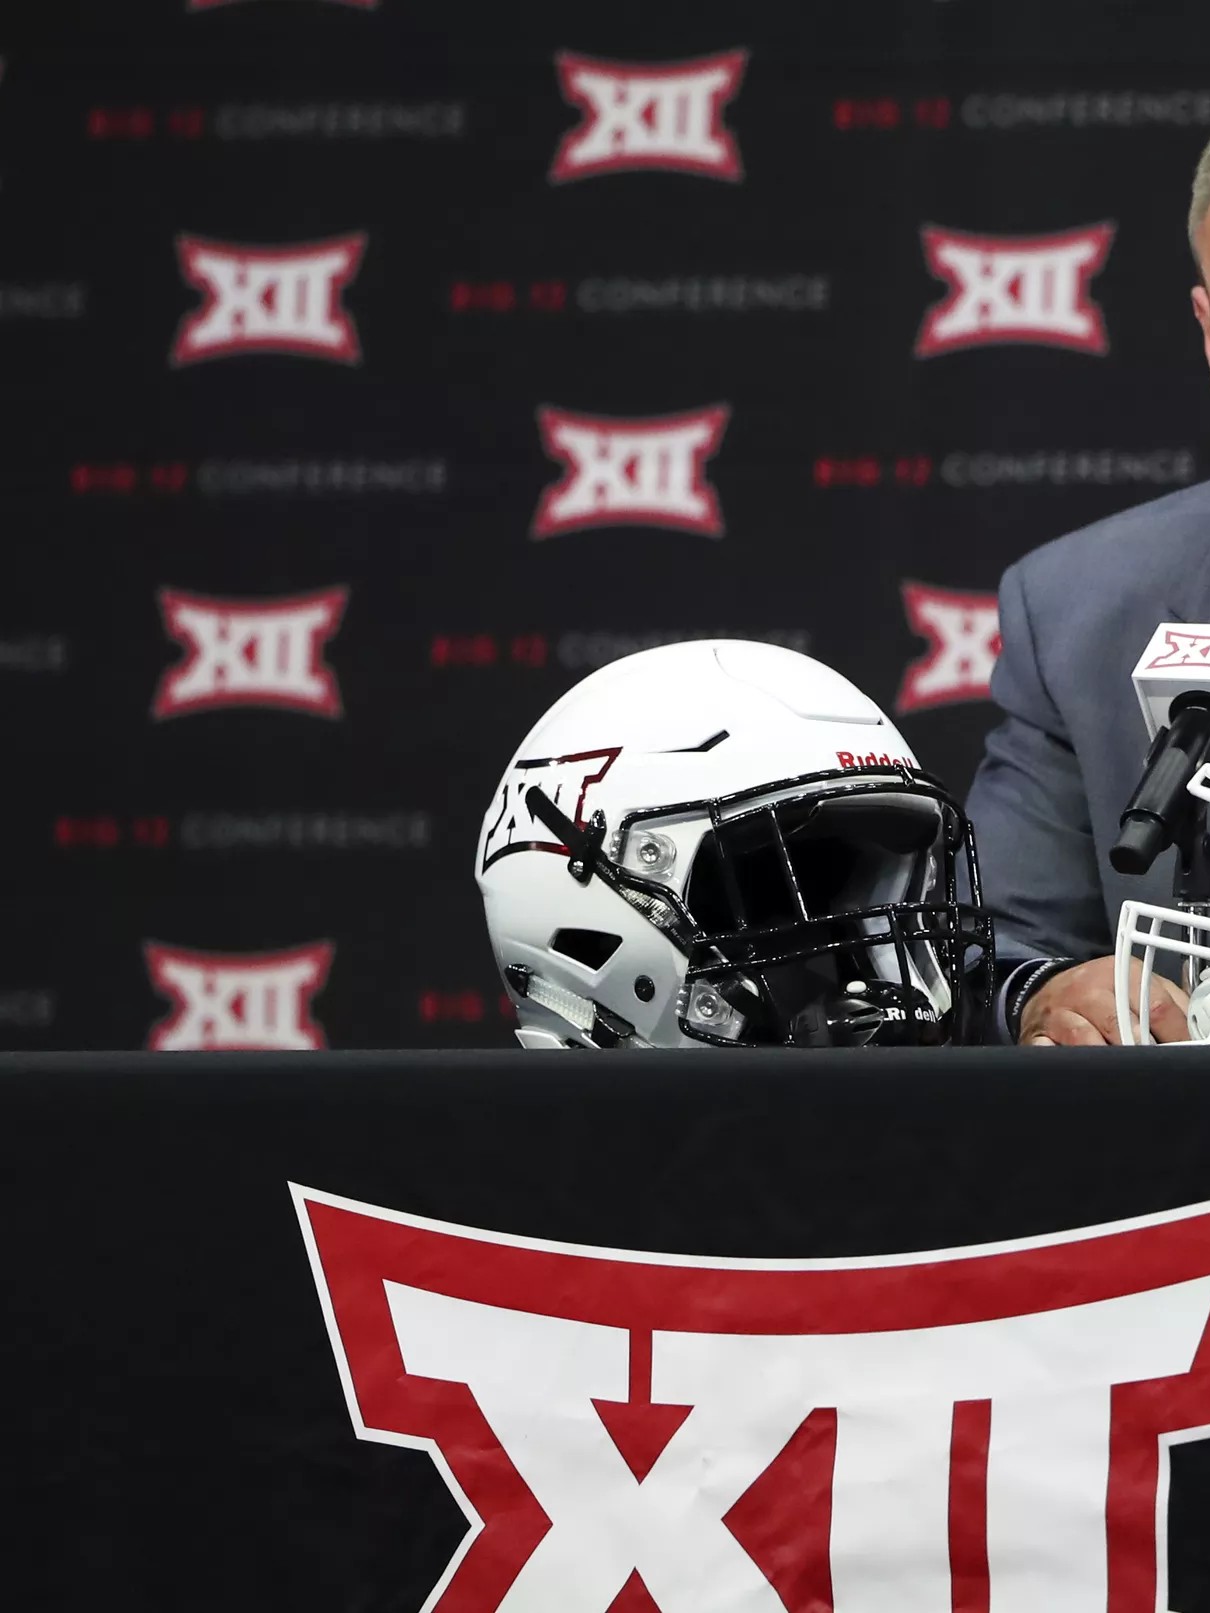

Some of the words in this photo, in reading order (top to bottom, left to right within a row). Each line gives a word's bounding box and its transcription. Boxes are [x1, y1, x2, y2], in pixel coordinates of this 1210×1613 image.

[566, 65, 732, 167] XII
[187, 249, 350, 350] XII
[930, 237, 1099, 342] XII
[547, 419, 715, 523] XII
[940, 450, 1195, 488] CONFERENCE
[169, 603, 331, 703] XII
[157, 957, 318, 1050] XII
[883, 1006, 937, 1023] Ridell
